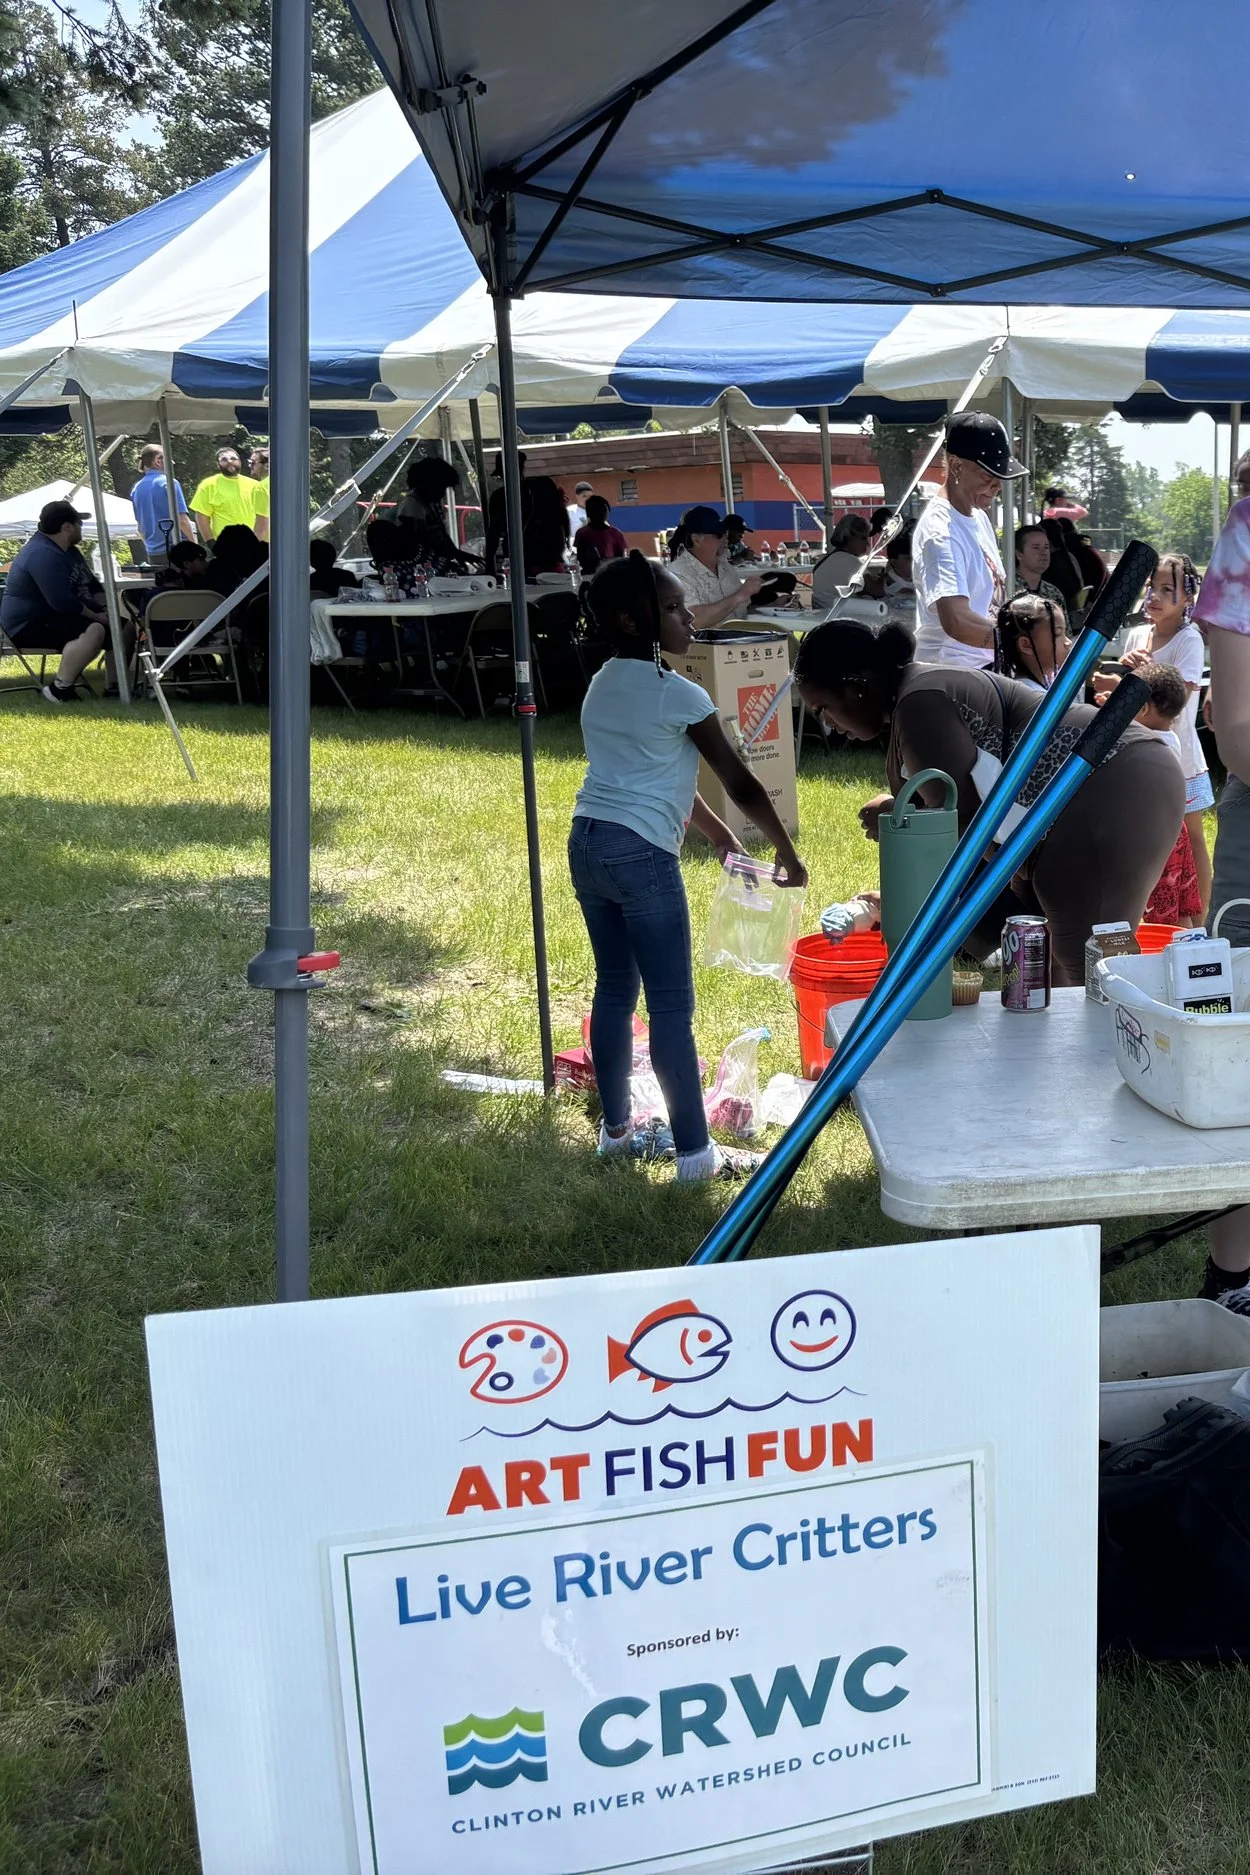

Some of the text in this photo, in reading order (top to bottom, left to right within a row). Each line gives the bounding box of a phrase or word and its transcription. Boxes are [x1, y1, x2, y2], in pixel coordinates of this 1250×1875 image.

[742, 692, 759, 715] THE
[1185, 1003, 1229, 1014] Bubble
[446, 1418, 874, 1516] ART FISH FUN
[395, 1507, 938, 1626] Live River Critters
[626, 1627, 740, 1657] Sponsored by:
[578, 1645, 910, 1768] CRWC
[451, 1732, 912, 1834] CLINTON RIVER WATERSHED COUNCIL
